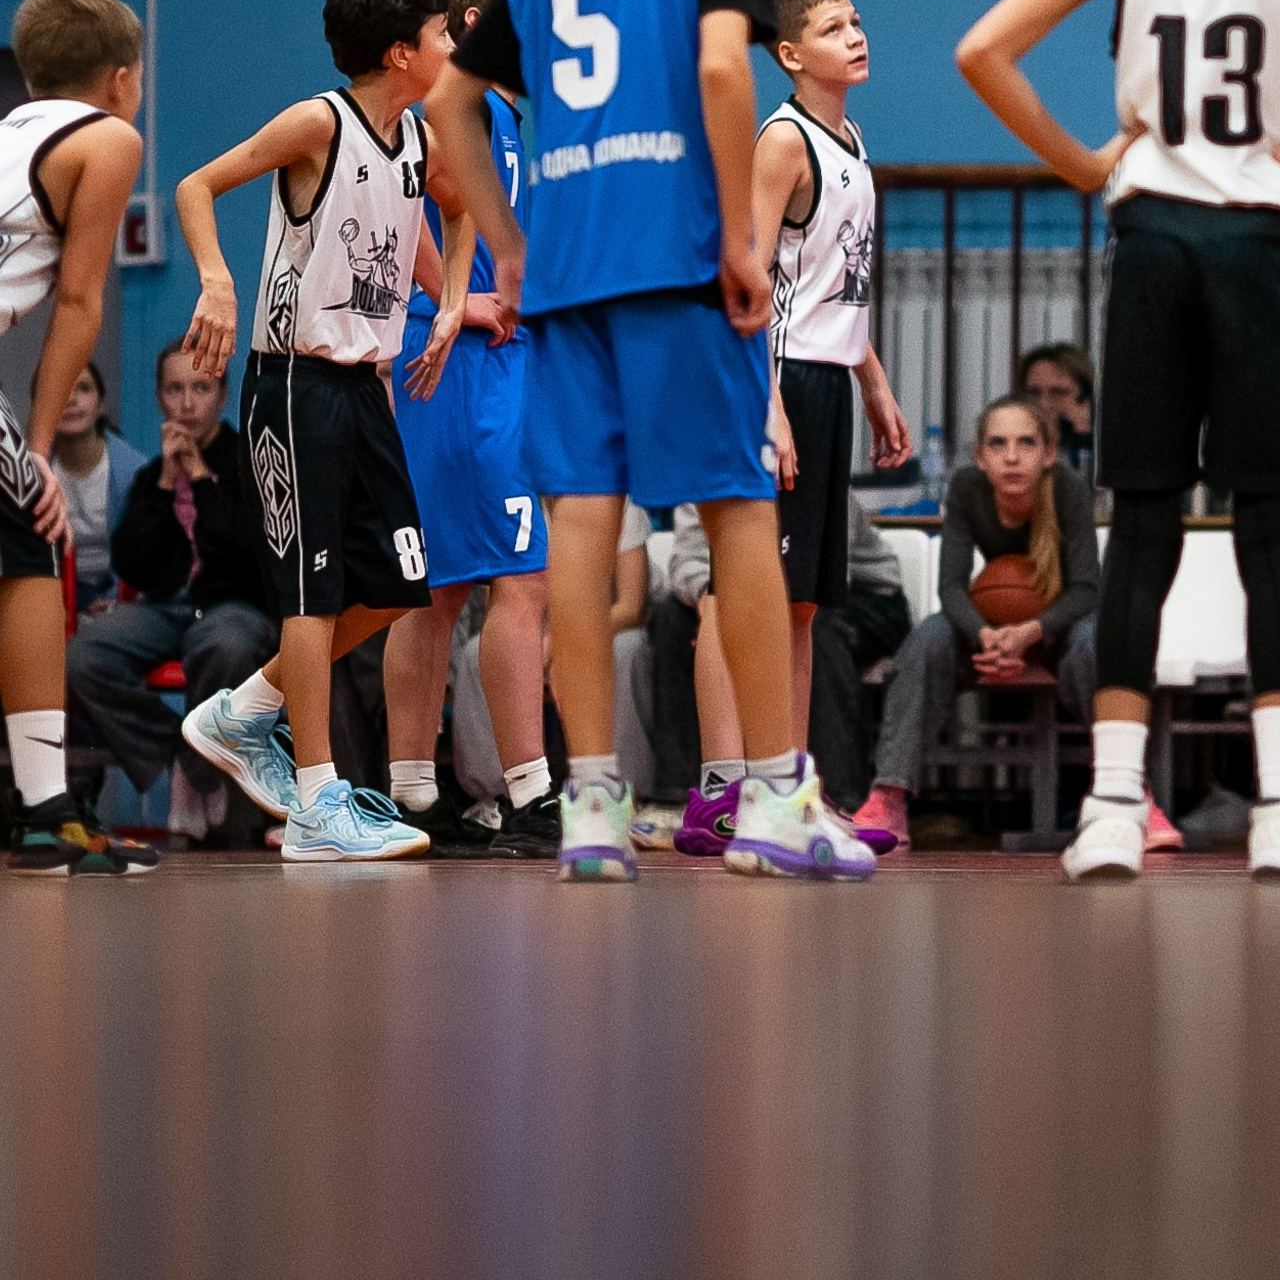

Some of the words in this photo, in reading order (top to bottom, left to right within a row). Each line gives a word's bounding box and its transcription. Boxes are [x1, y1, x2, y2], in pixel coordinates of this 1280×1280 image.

[1149, 14, 1265, 147] 13
[504, 150, 519, 208] 7
[504, 496, 533, 553] 7
